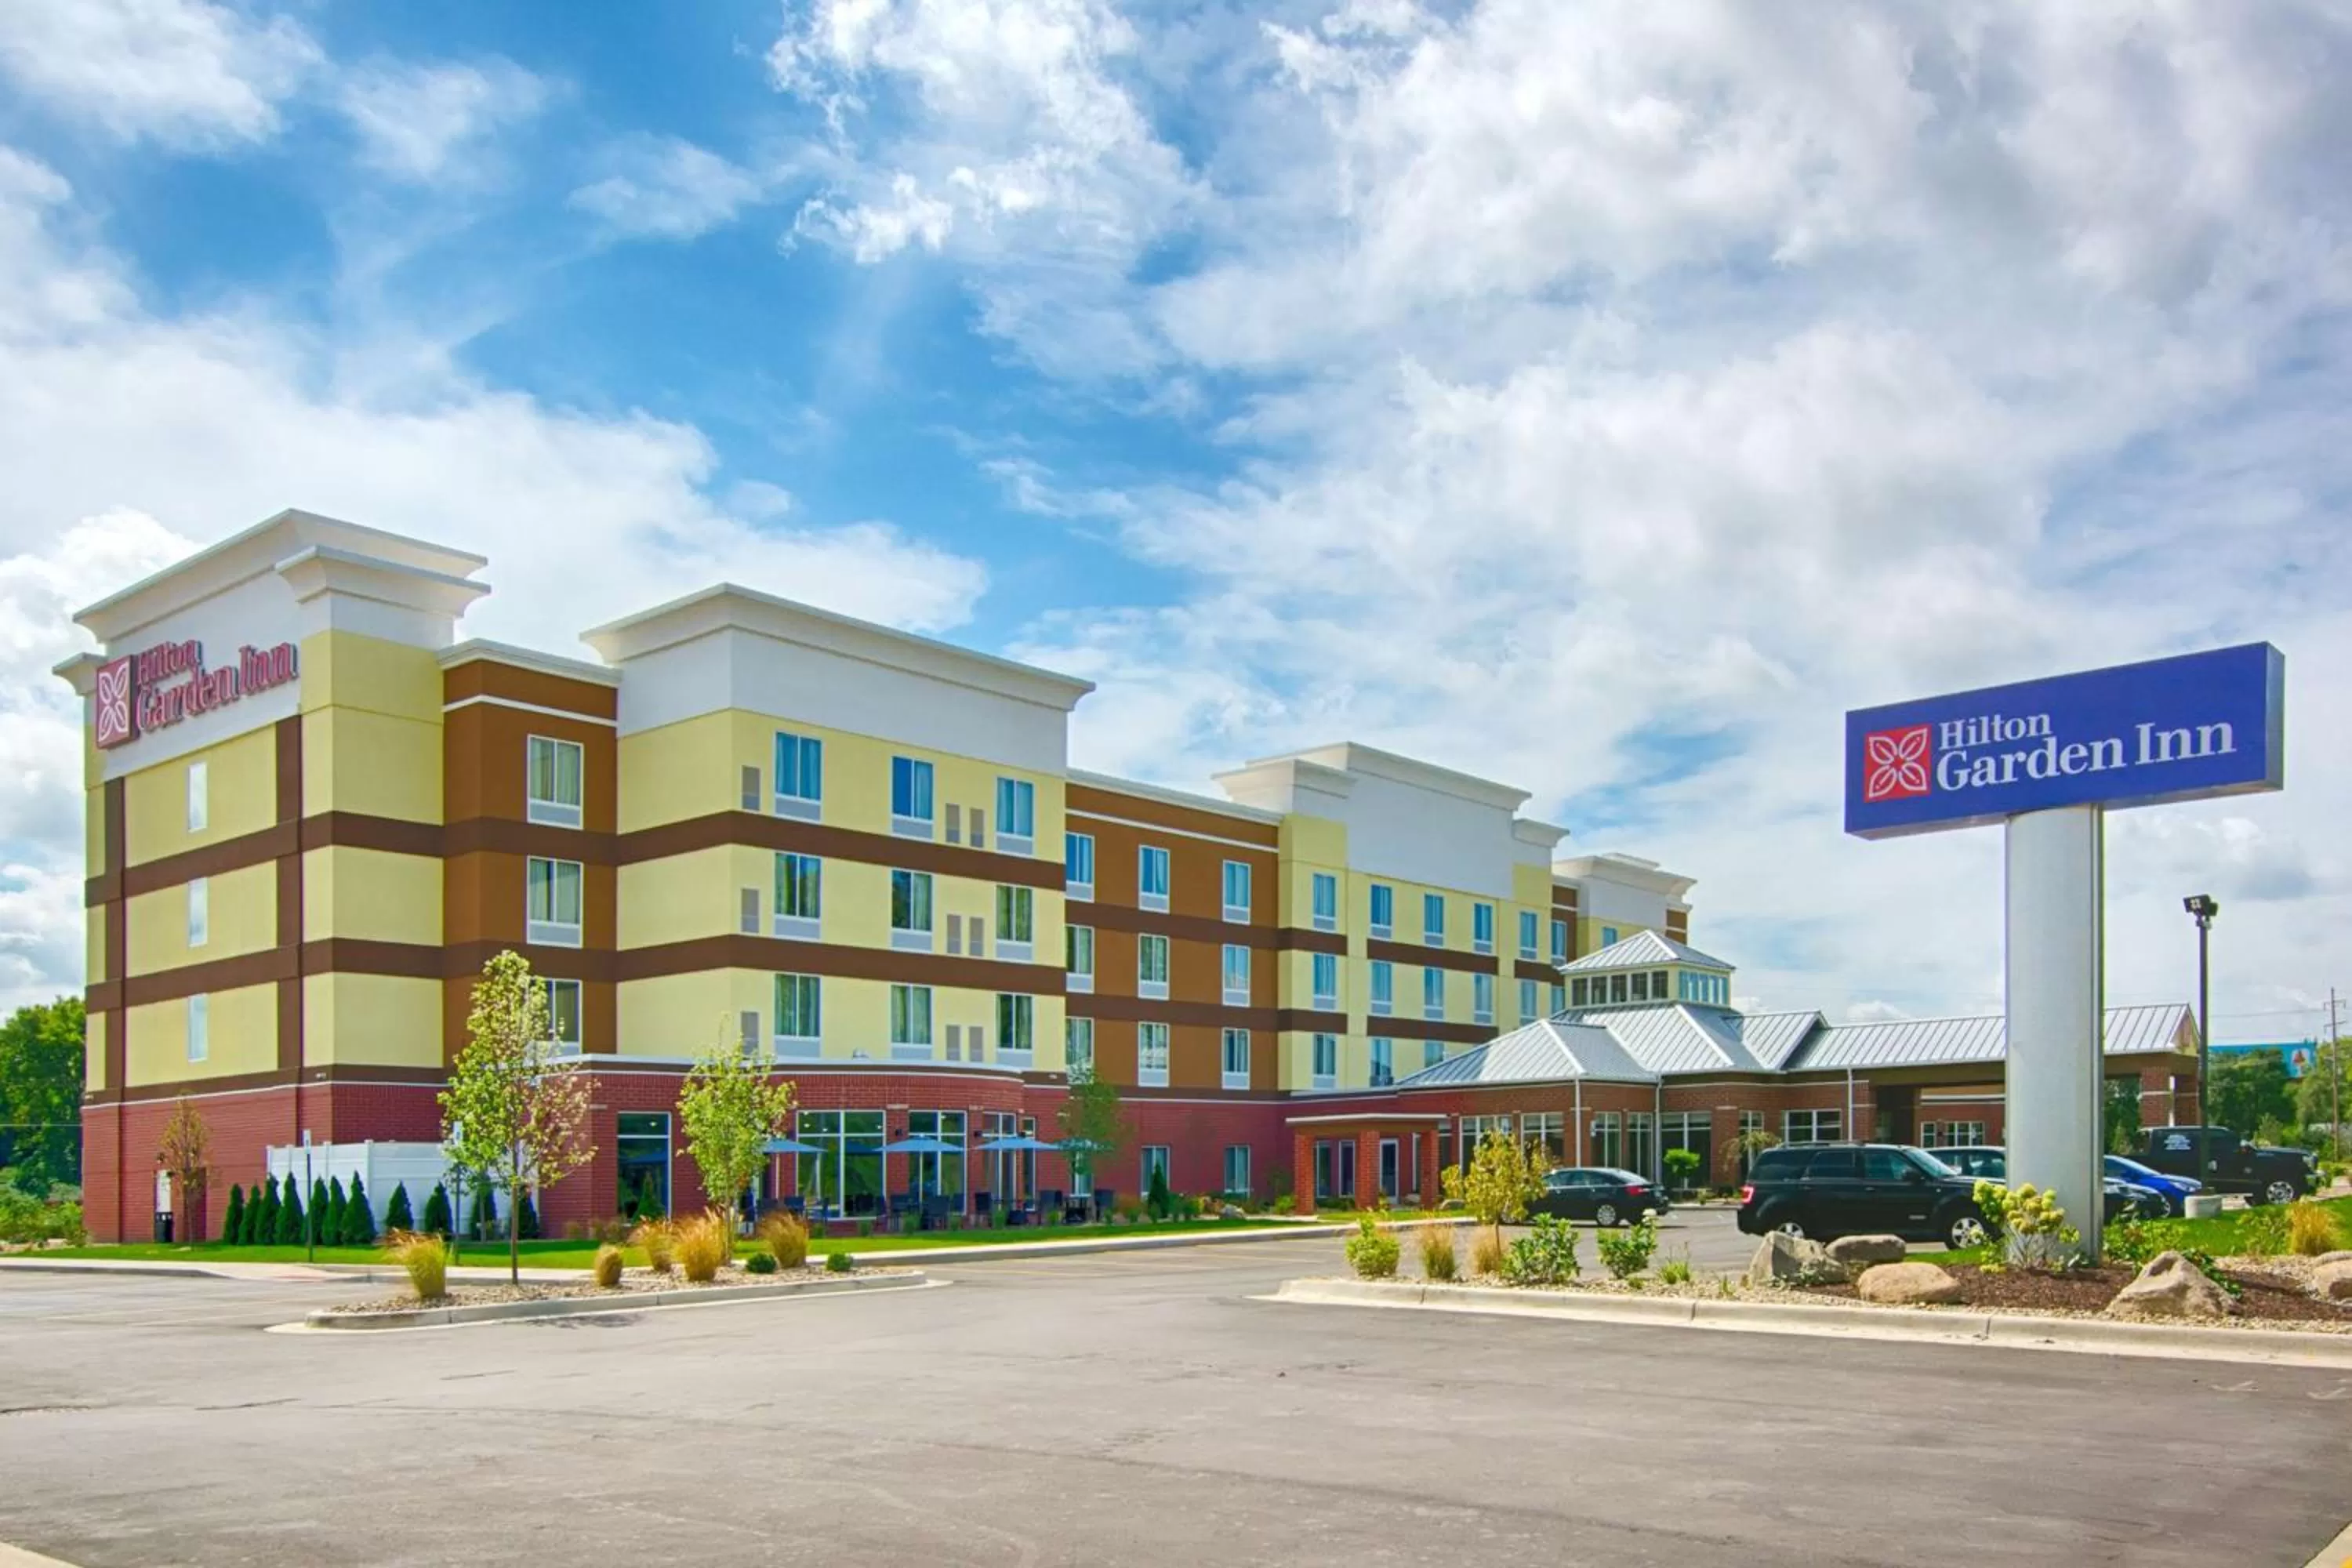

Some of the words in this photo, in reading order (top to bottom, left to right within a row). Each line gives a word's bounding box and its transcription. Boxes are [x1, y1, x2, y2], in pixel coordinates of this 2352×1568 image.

[136, 666, 239, 731] Garden
[238, 643, 298, 695] Inn
[138, 639, 202, 684] Hilton
[1936, 735, 2127, 791] Garden
[2136, 721, 2237, 765] Inn
[1939, 714, 2052, 750] Hilton
